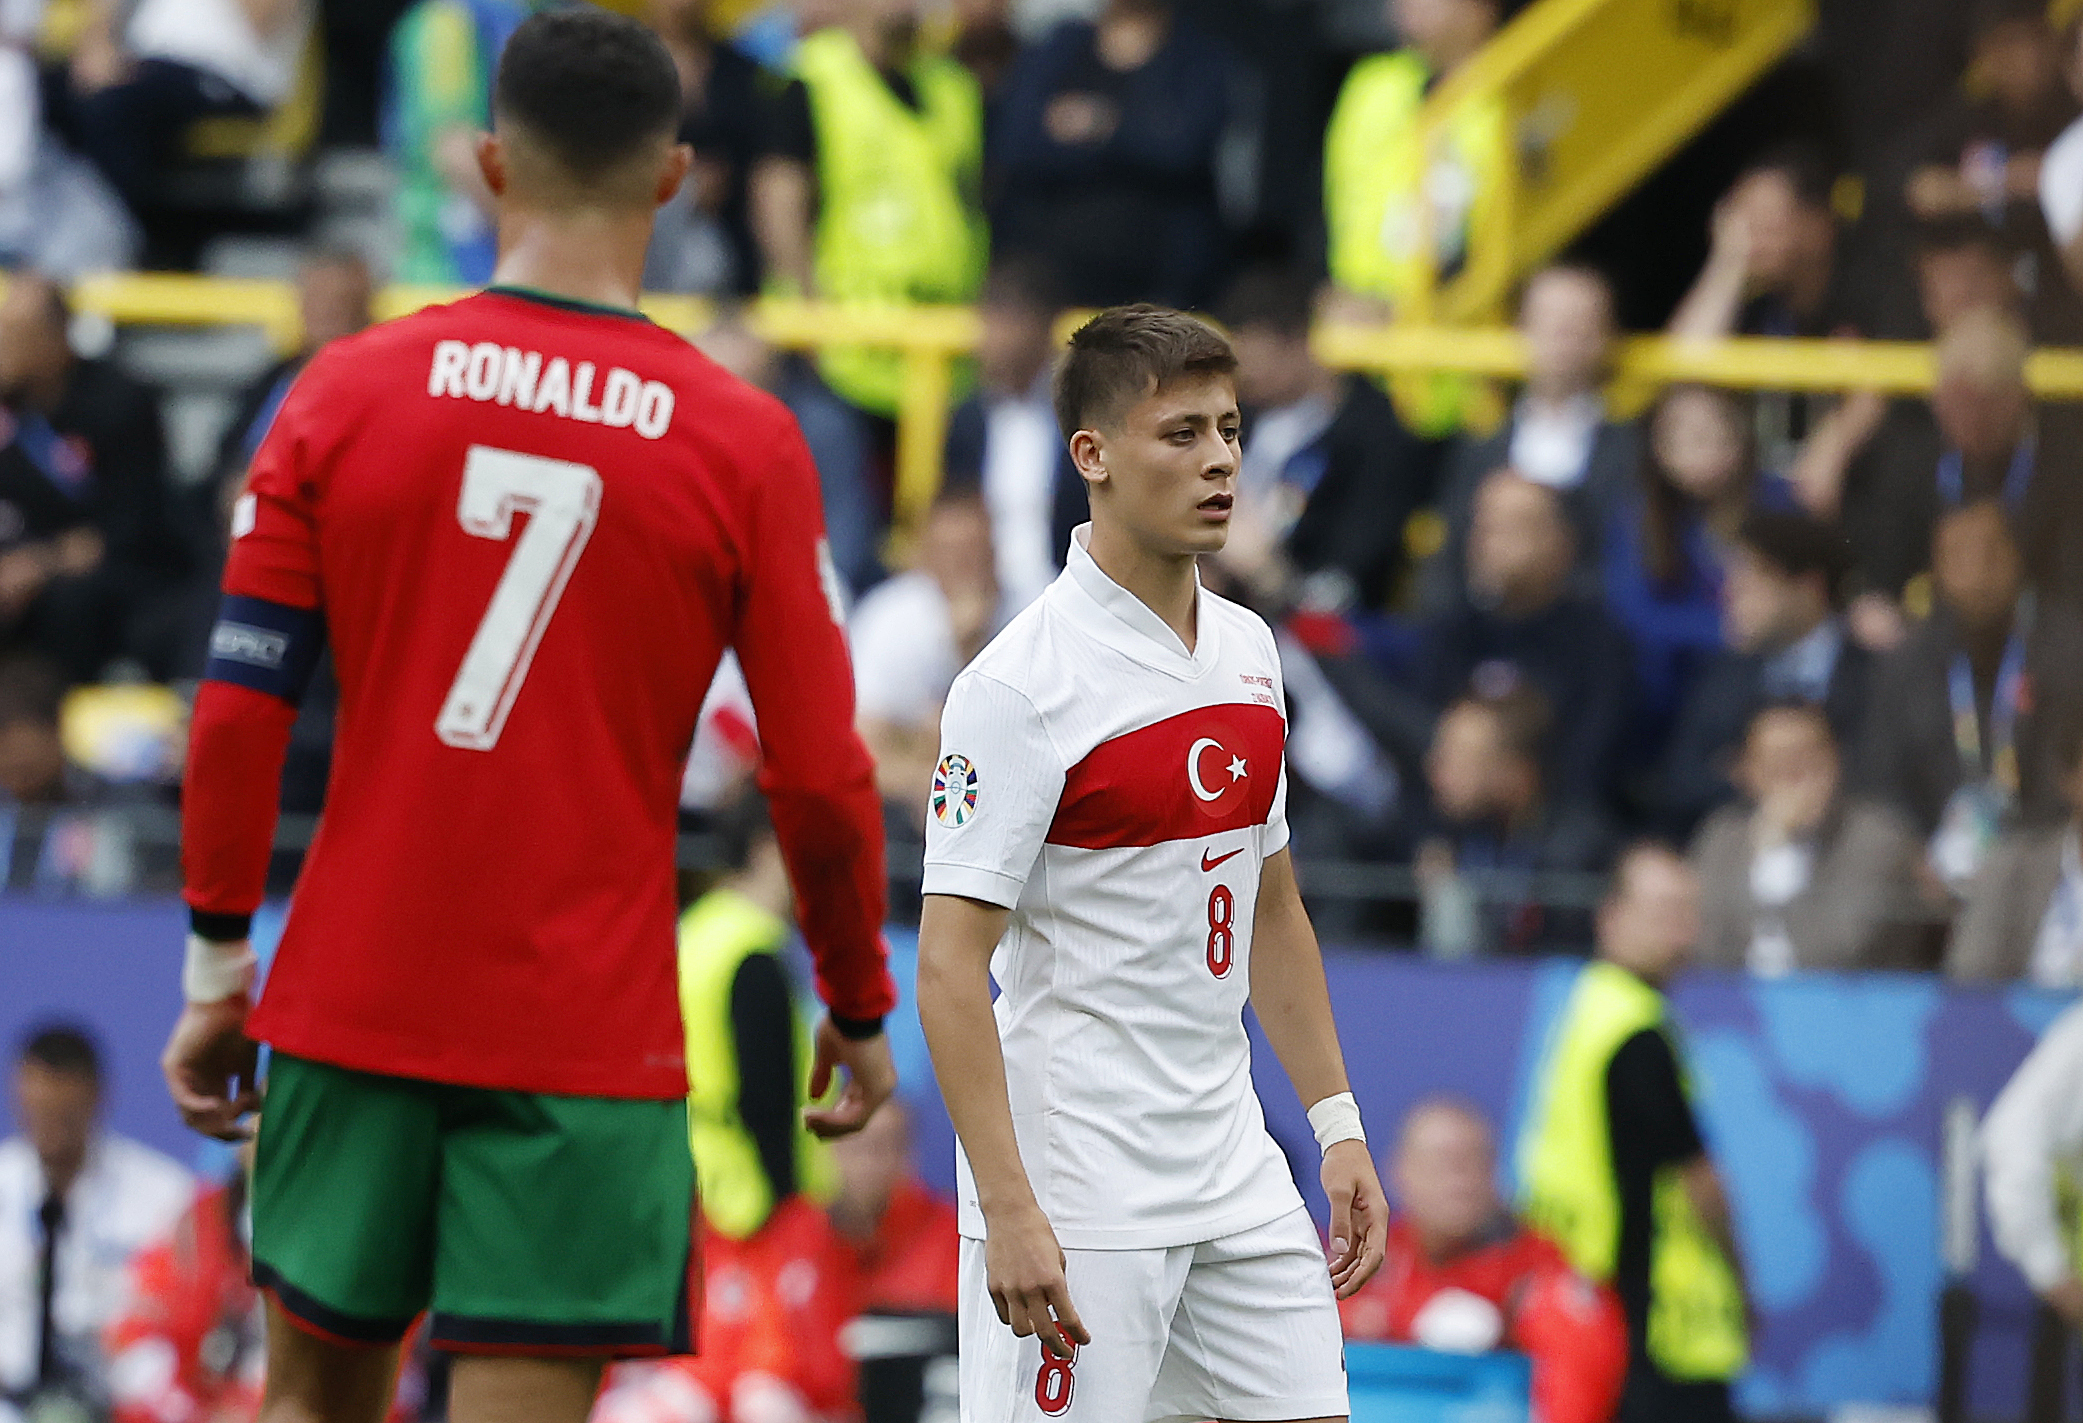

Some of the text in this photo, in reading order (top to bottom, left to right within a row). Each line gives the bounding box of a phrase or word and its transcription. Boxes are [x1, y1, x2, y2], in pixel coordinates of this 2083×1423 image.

[427, 339, 676, 440] RONALDO
[433, 443, 605, 752] 7
[1206, 884, 1235, 980] 8
[1034, 1303, 1081, 1418] 8
